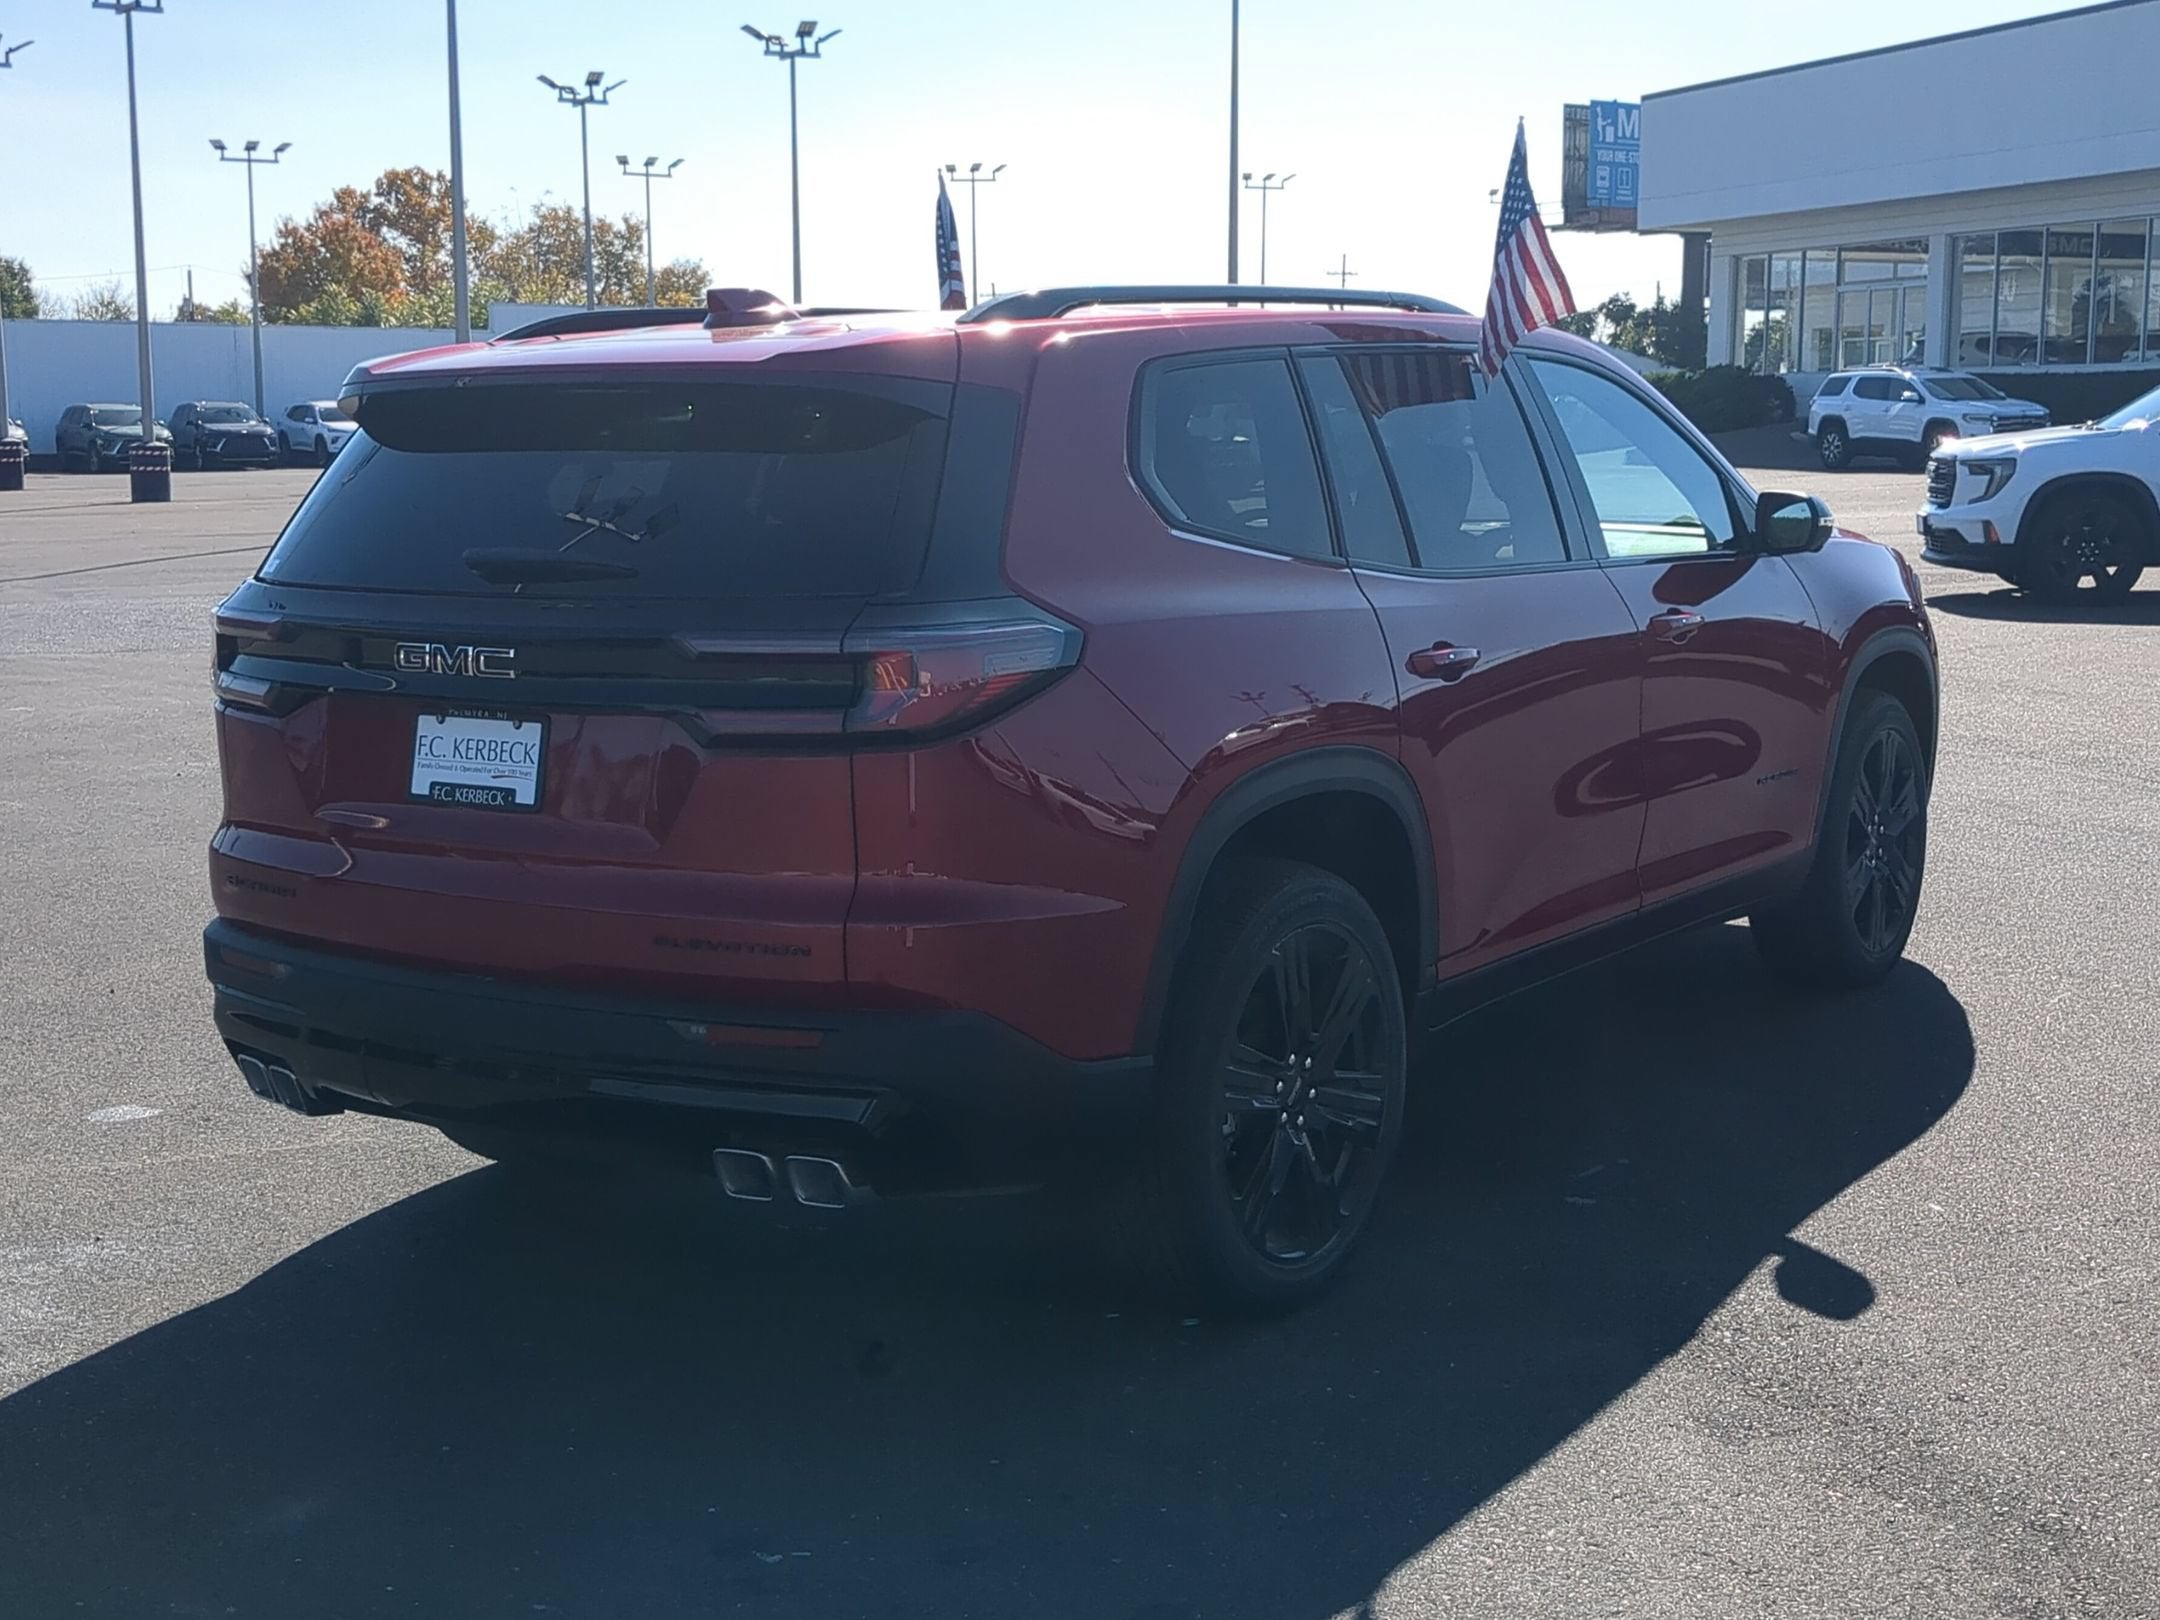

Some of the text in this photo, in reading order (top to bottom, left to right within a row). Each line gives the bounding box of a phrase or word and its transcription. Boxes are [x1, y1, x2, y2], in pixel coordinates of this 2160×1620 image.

[394, 642, 515, 679] GMC
[417, 735, 537, 765] F.C. KERBECK
[433, 785, 505, 806] F.C. KERBECK
